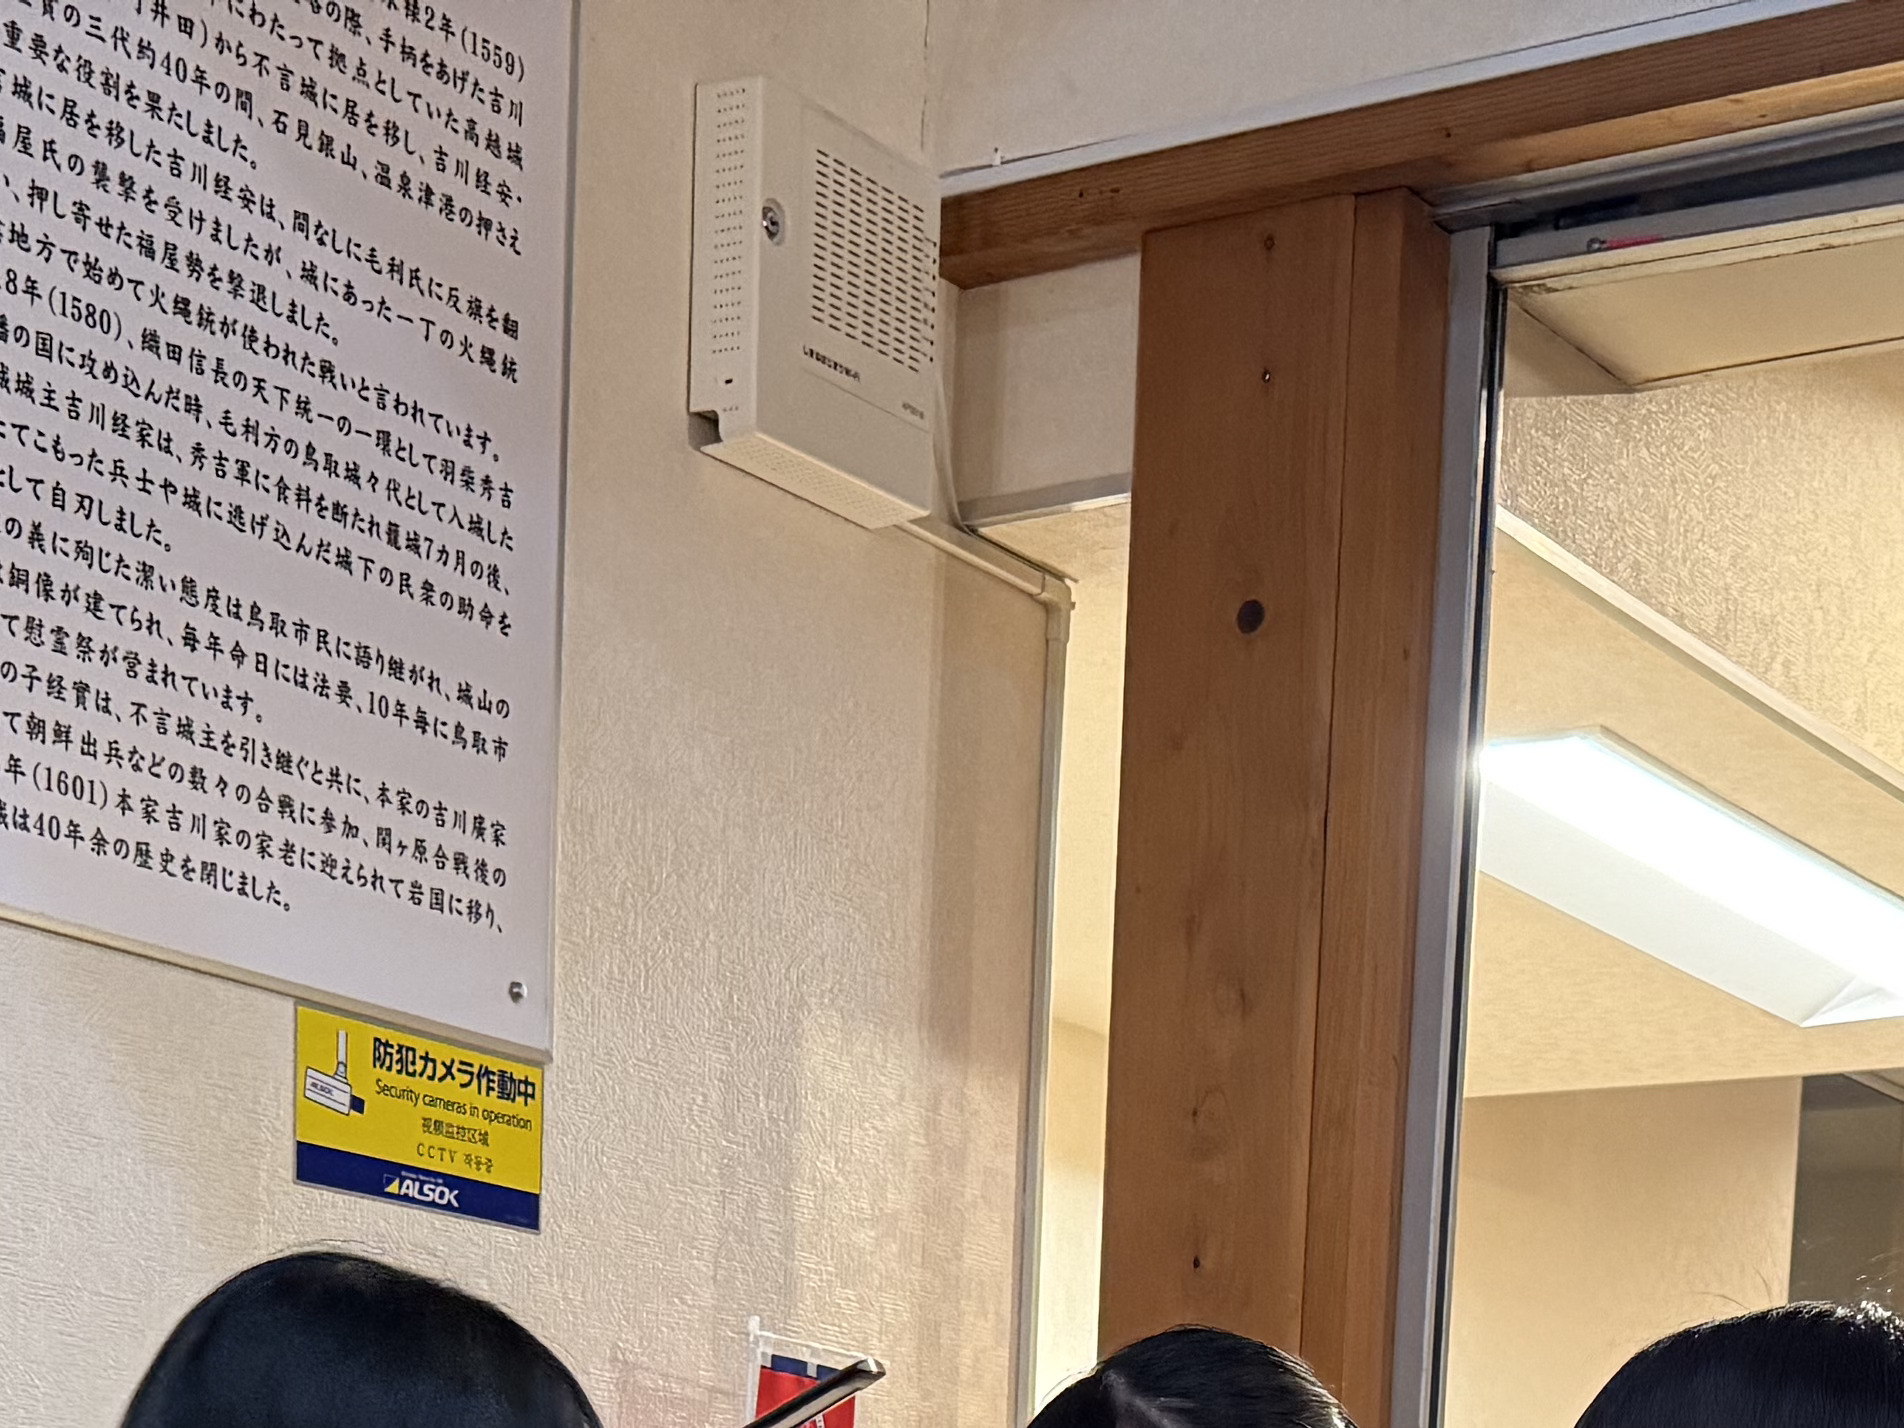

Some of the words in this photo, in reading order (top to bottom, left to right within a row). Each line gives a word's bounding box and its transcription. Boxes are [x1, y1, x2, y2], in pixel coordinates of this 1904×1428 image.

[371, 1035, 537, 1107] 防犯カメラ作動中
[375, 1077, 421, 1108] Security
[422, 1092, 468, 1117] cameras
[469, 1101, 480, 1119] in
[481, 1108, 533, 1133] operation
[416, 1142, 460, 1166] CCTV
[399, 1178, 461, 1209] ALSOK
